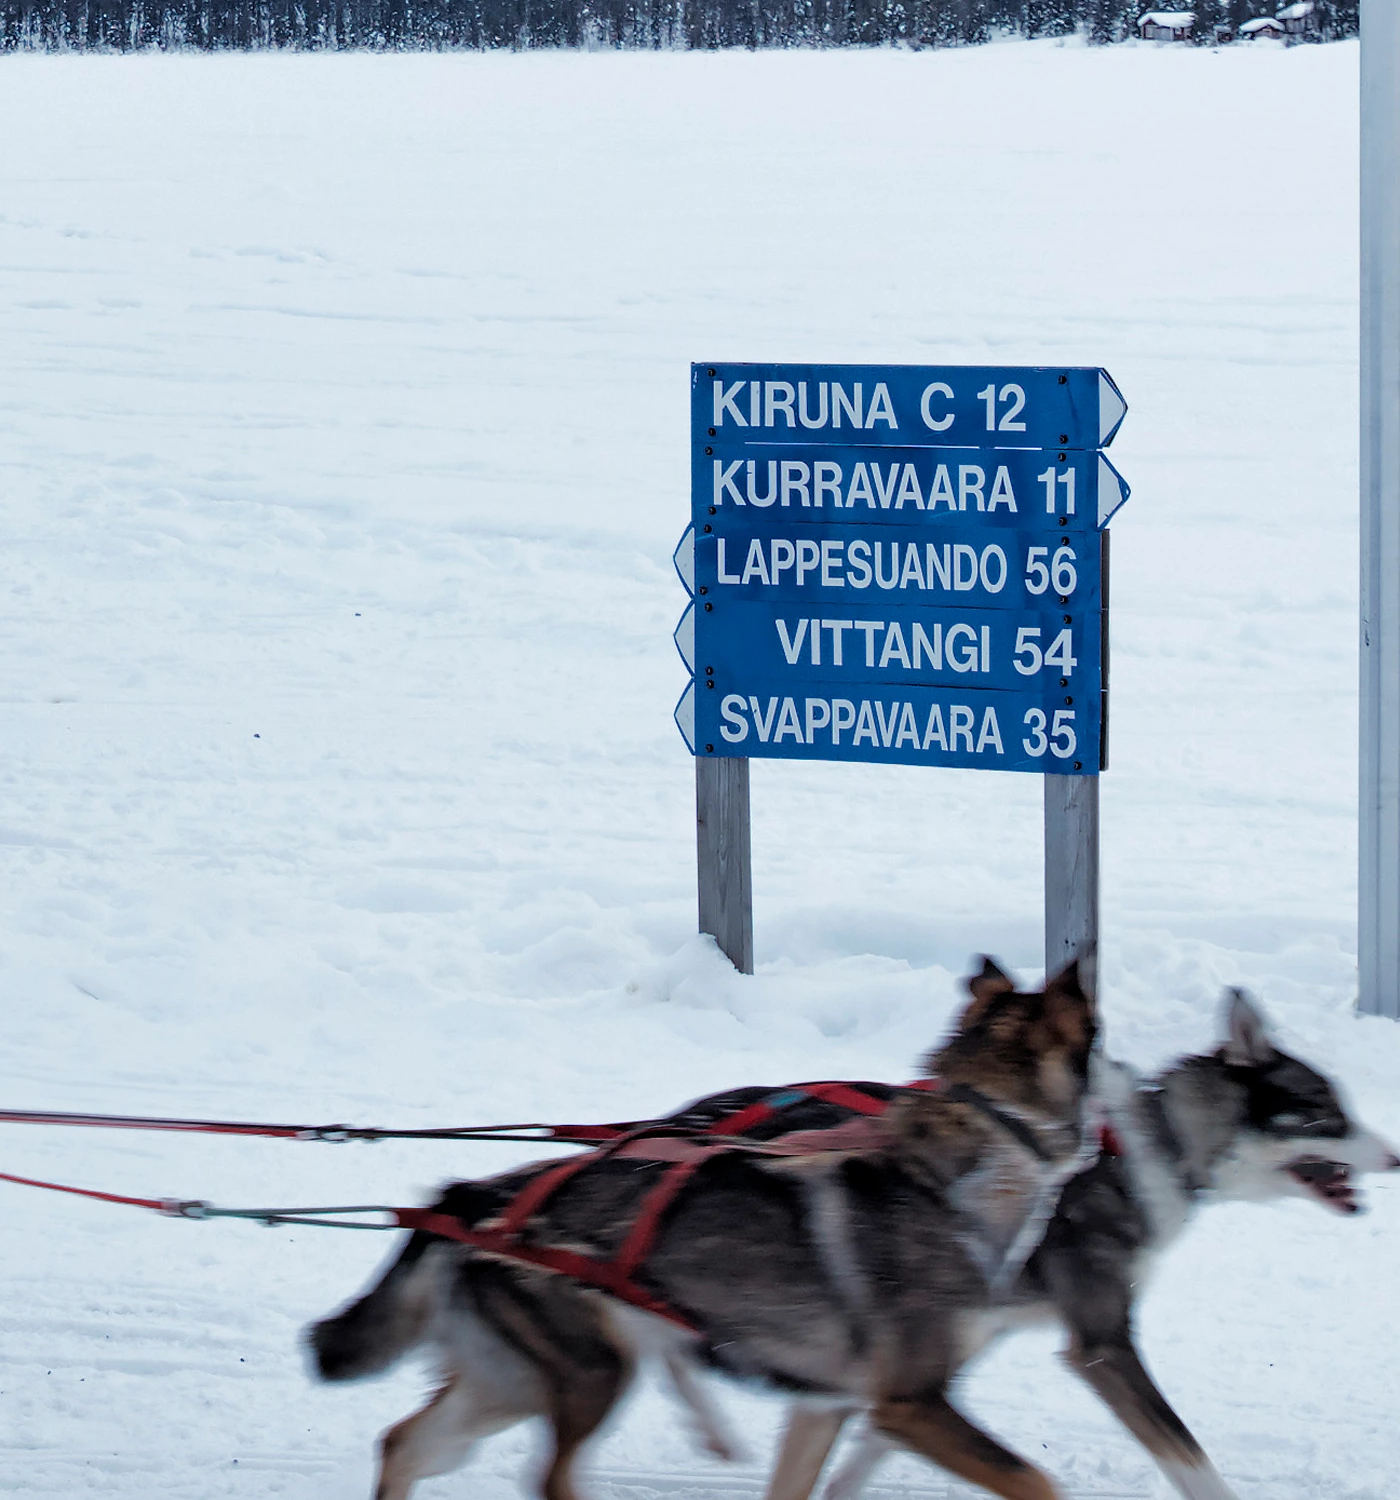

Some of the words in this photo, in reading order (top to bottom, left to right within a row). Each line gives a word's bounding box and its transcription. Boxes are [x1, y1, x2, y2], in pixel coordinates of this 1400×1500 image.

[713, 380, 898, 429] KIRUNA
[921, 383, 955, 431] C
[977, 384, 1026, 432] 12
[713, 460, 1018, 513] KURRAVAARA
[1037, 466, 1075, 515] 11
[717, 538, 1008, 593] LAPPESUANDO
[1024, 547, 1077, 596] 56
[775, 619, 991, 673] VITTANGI
[1013, 628, 1077, 676] 54
[719, 694, 1005, 754] SVAPPAVAARA
[1022, 709, 1076, 758] 35
